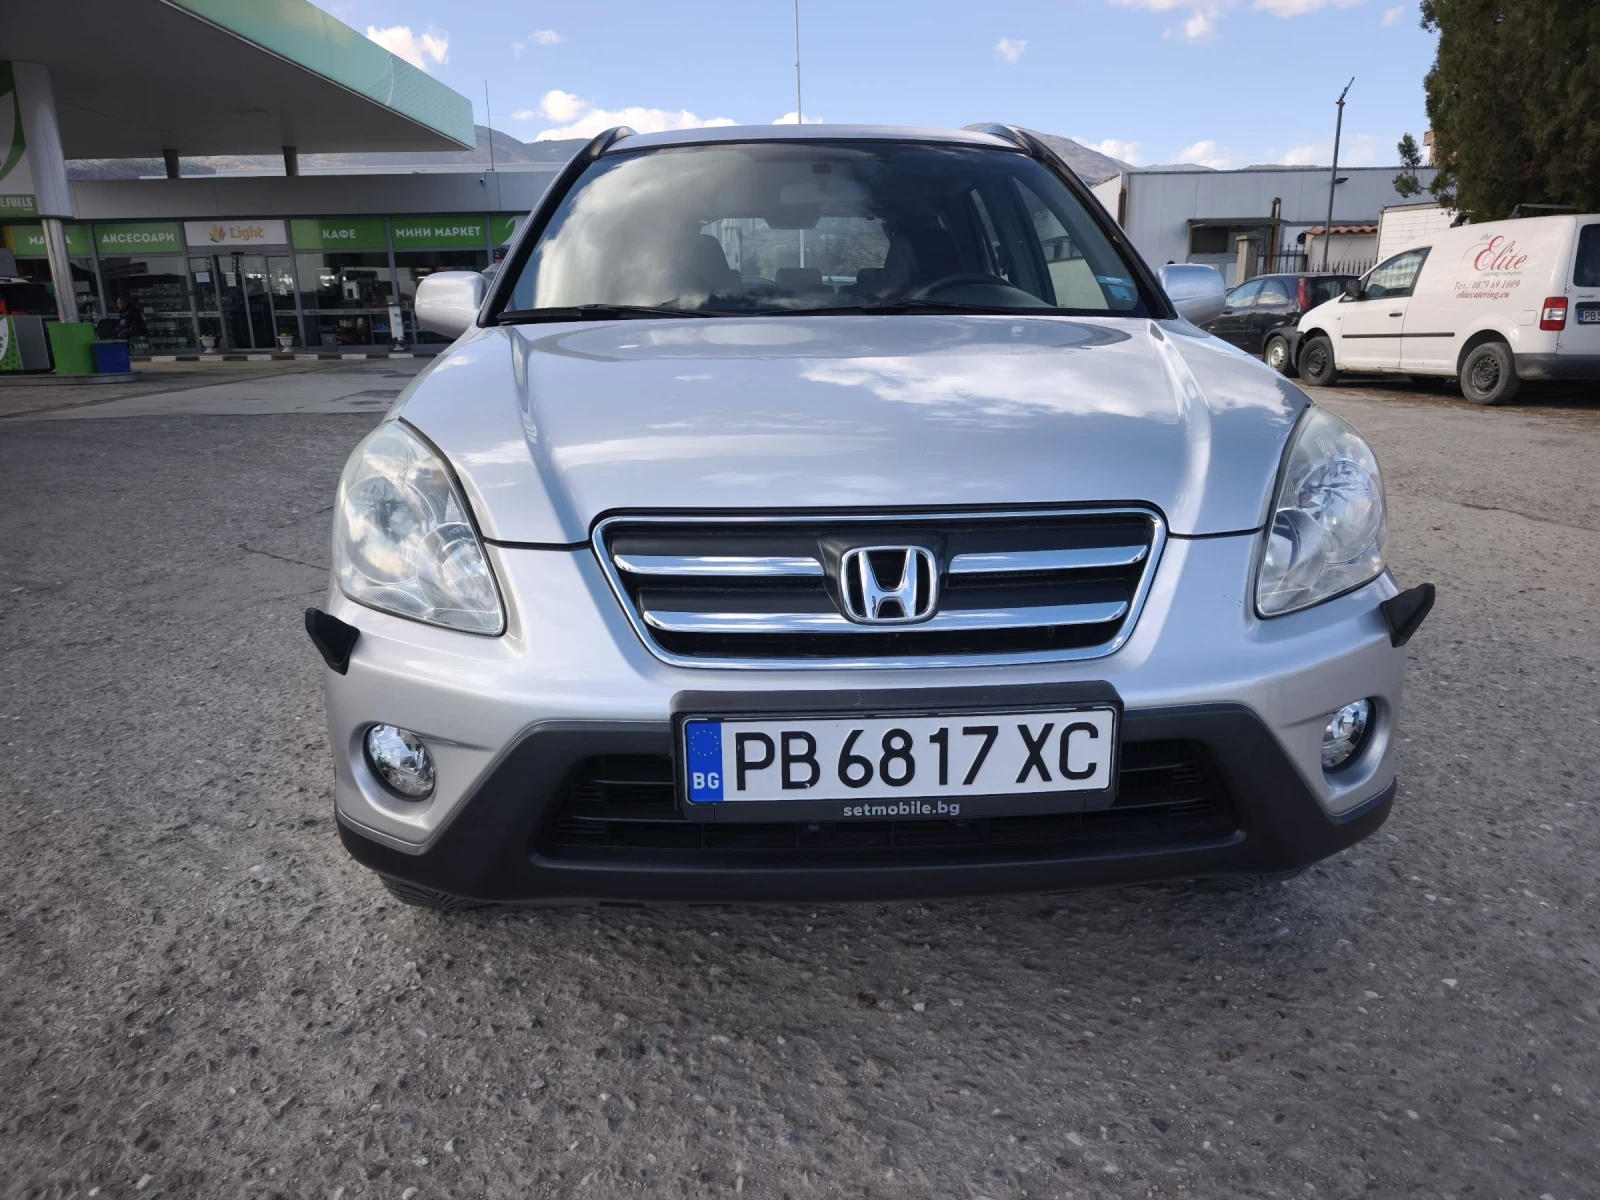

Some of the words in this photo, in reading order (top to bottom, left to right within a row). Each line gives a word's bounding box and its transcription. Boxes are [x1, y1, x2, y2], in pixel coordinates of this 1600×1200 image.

[102, 230, 175, 244] АКСЕСОАРИ
[229, 225, 264, 241] Light
[322, 228, 356, 239] КАФЕ
[395, 227, 431, 238] МИНИ
[434, 226, 481, 237] МАРКЕТ
[28, 235, 72, 245] МАА
[1464, 235, 1529, 271] Elite
[1501, 279, 1521, 289] 1009
[1456, 291, 1509, 300] elitecatering.eu
[734, 730, 821, 791] PB
[837, 725, 999, 789] 6817
[1014, 721, 1100, 783] XC
[692, 772, 720, 790] BG
[842, 799, 961, 819] setmobile.bg
